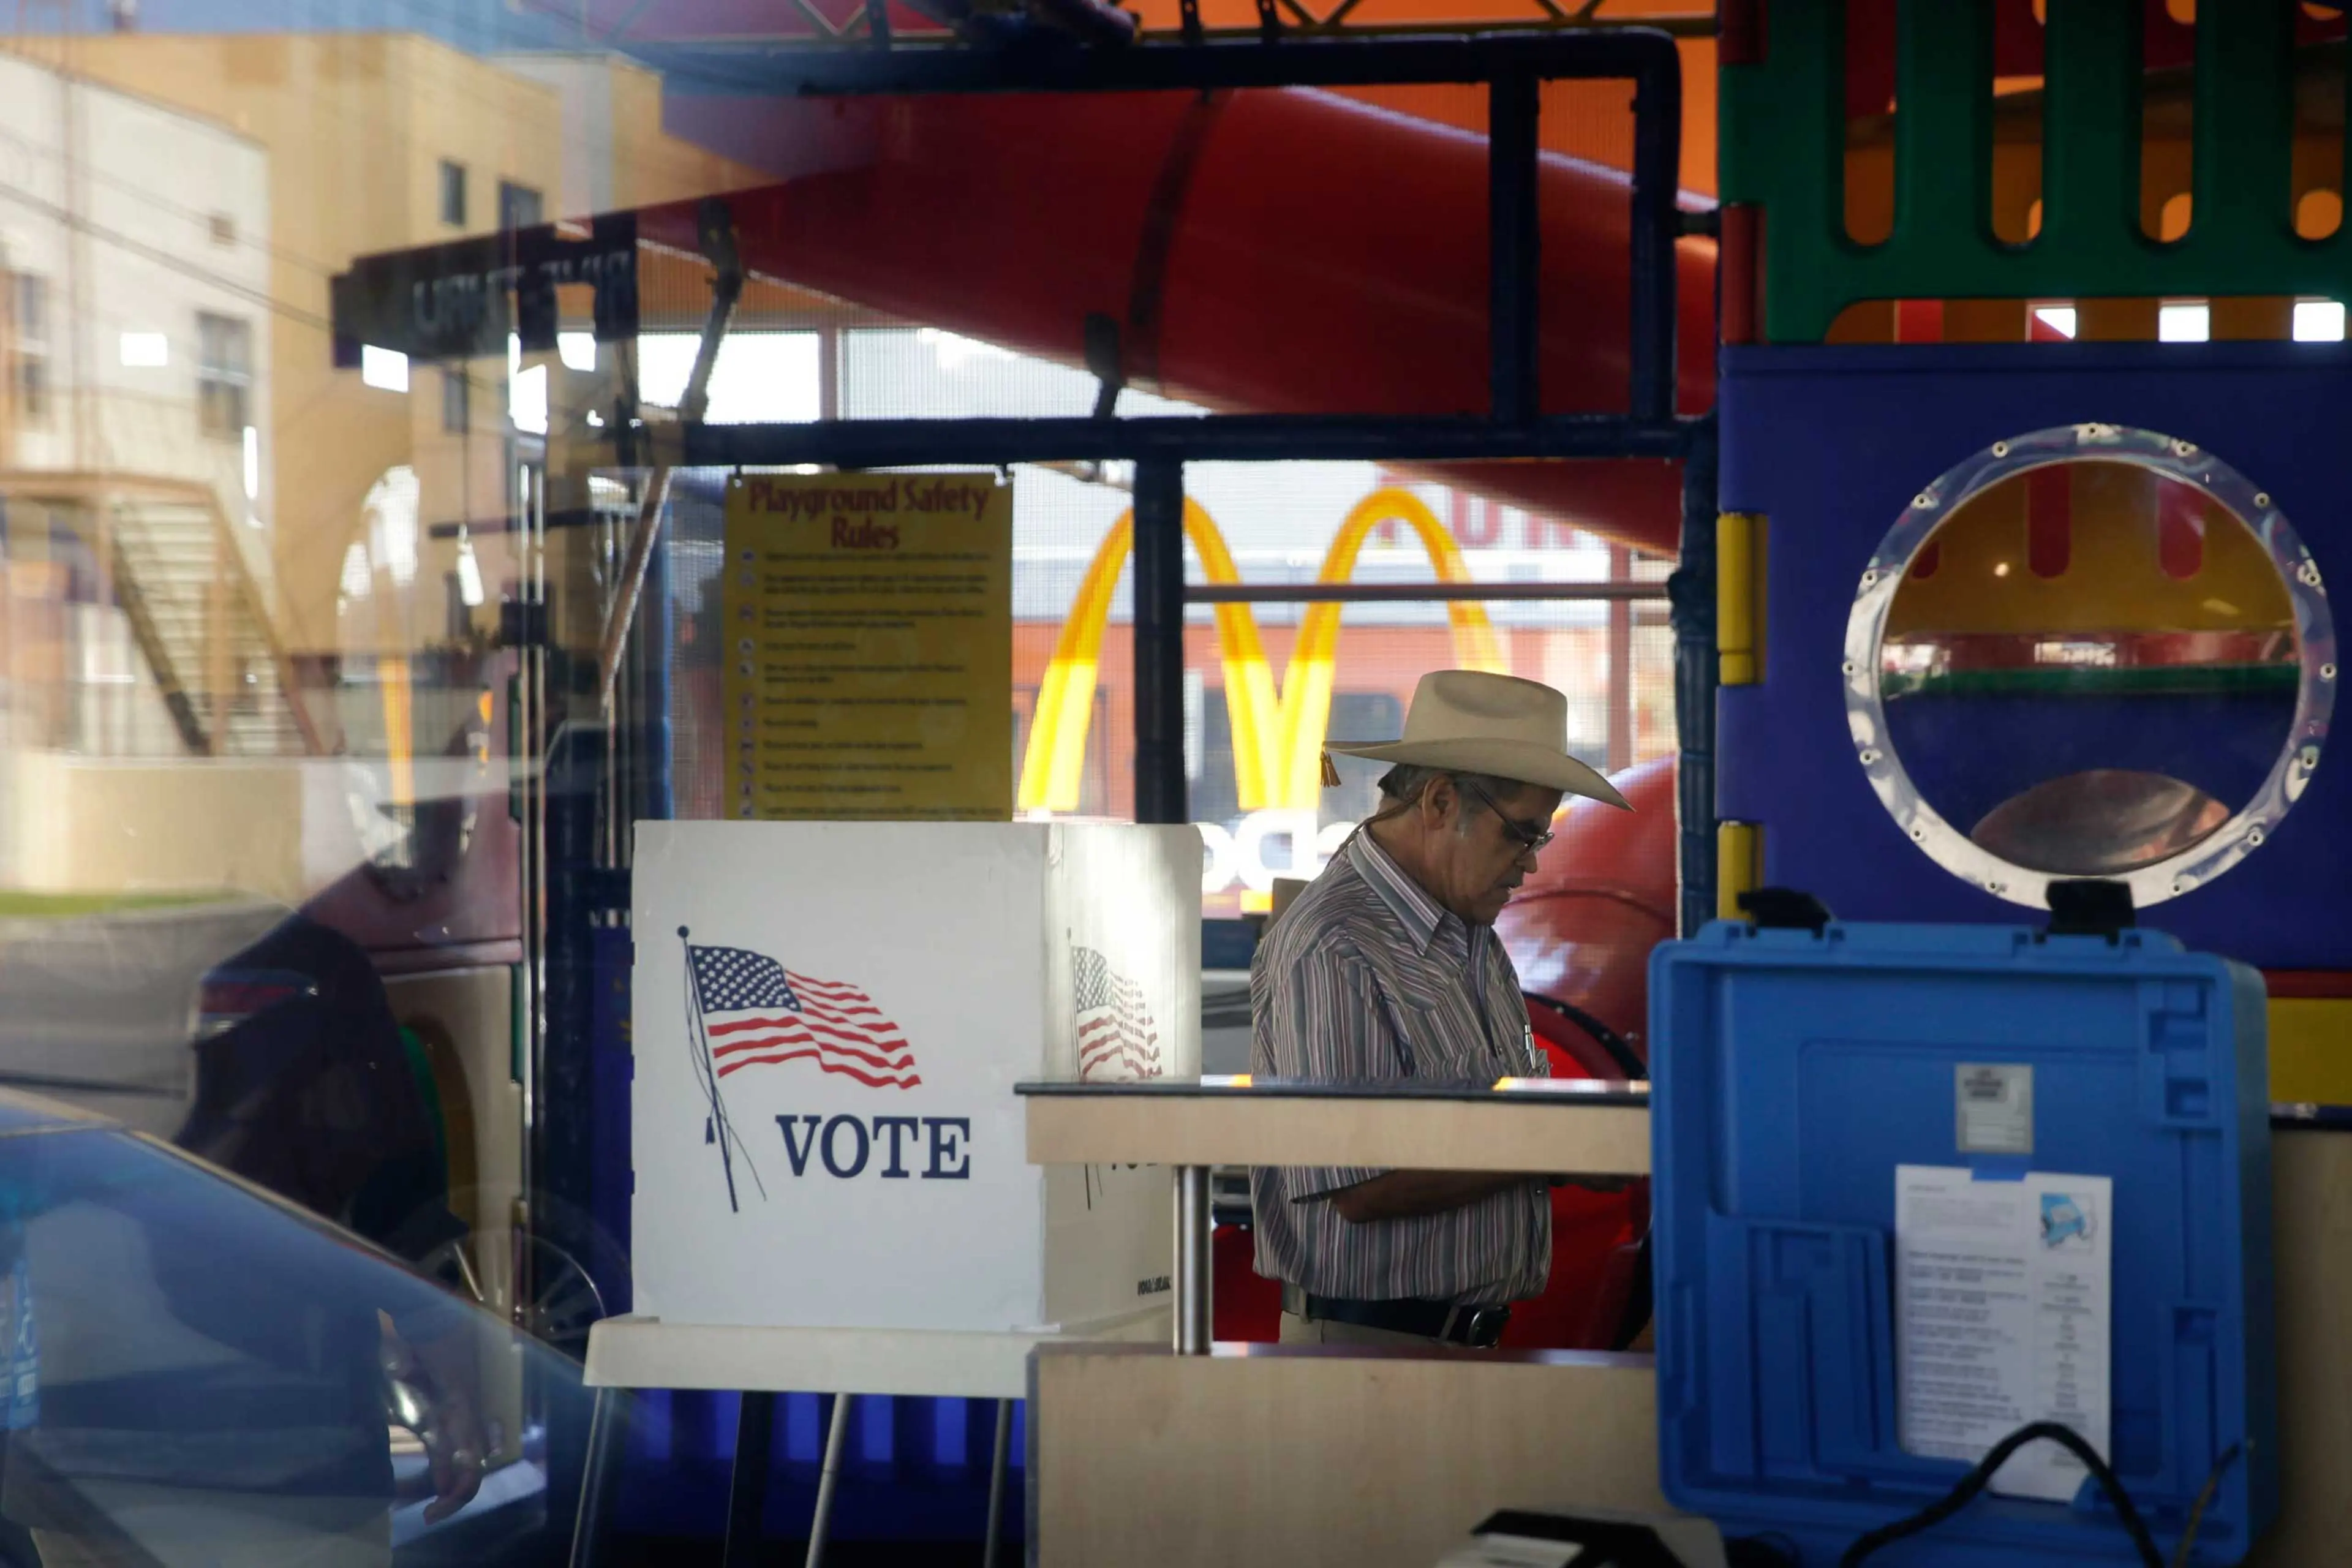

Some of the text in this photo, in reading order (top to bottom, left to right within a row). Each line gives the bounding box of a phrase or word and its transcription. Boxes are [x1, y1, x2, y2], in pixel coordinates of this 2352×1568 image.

[749, 478, 989, 521] Playground Safety
[831, 516, 900, 549] Rules
[774, 1113, 970, 1179] VOTE
